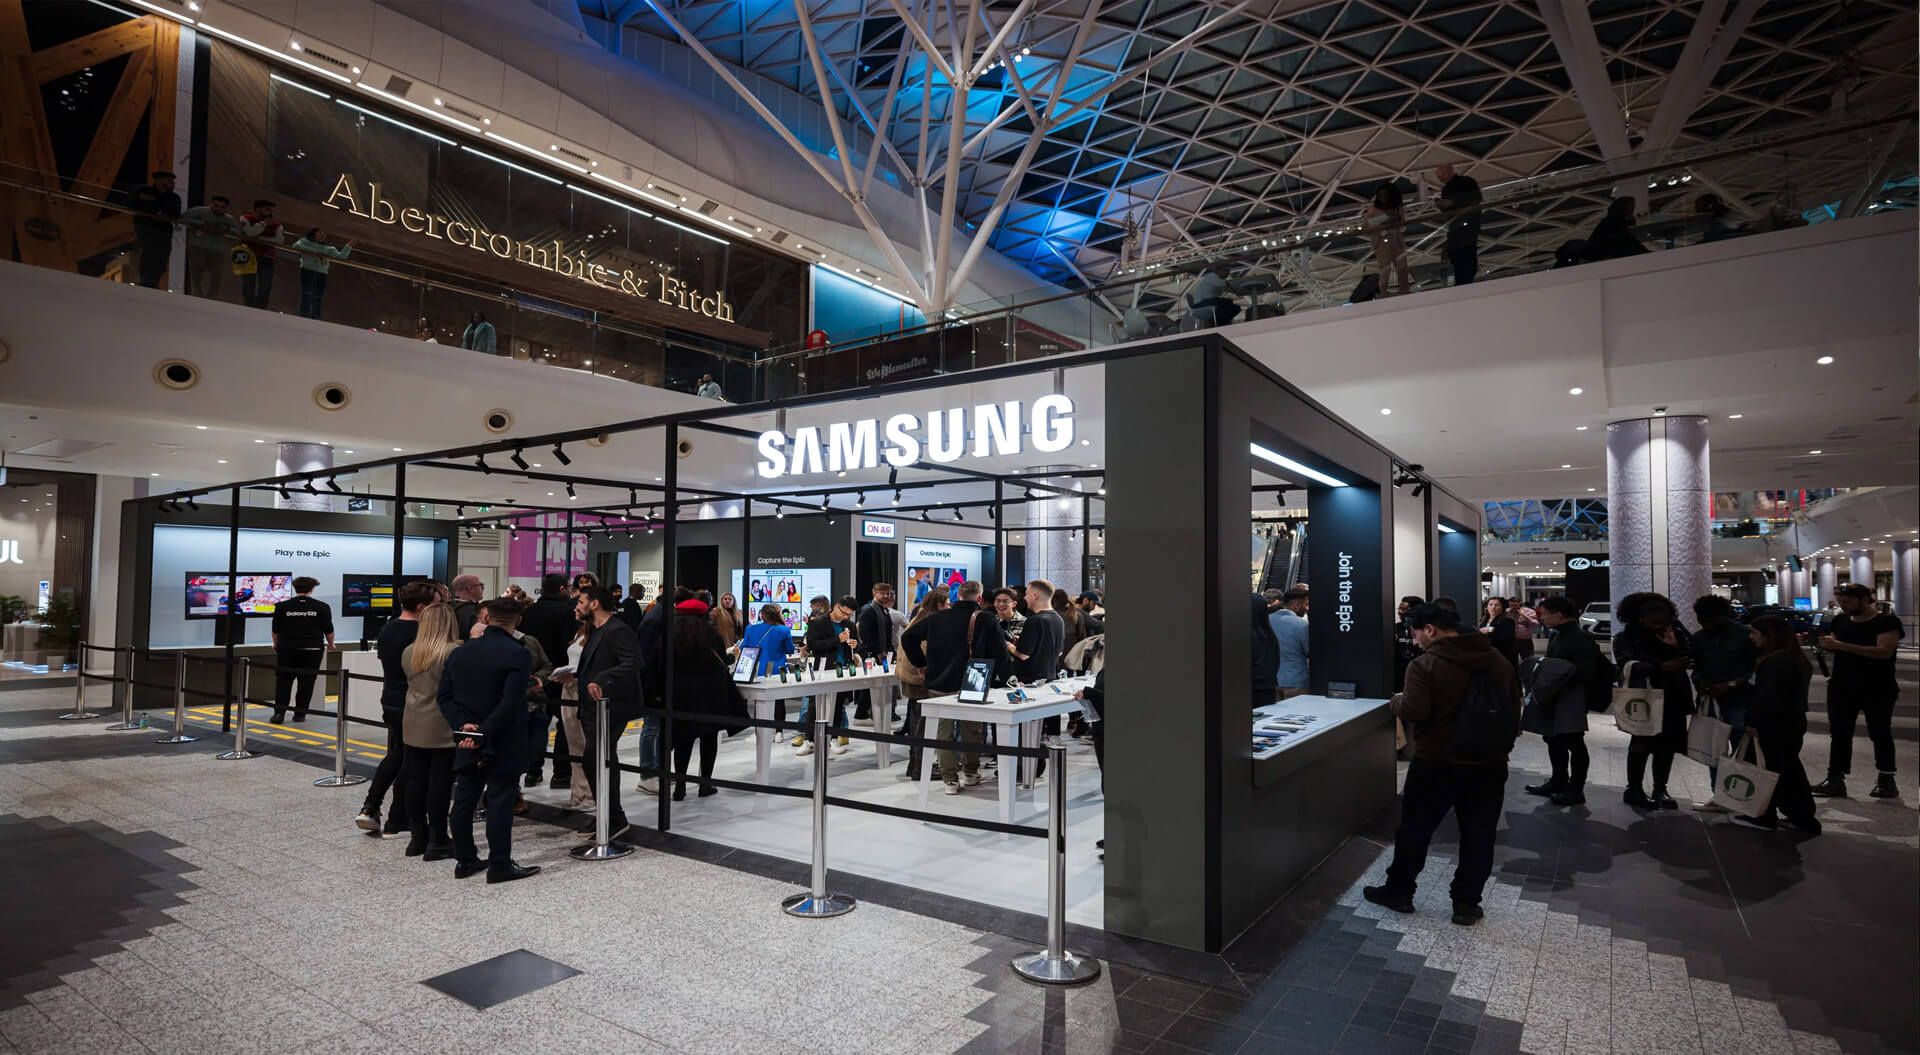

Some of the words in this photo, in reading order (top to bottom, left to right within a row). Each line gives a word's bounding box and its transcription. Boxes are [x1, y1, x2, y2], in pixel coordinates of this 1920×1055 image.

[321, 173, 608, 289] Abercrombie
[620, 269, 649, 298] &
[658, 273, 735, 324] Fitch
[757, 394, 1076, 480] SAMSUNG
[866, 524, 880, 534] ON
[880, 525, 892, 534] AIR
[275, 549, 294, 558] Play
[296, 549, 311, 557] the
[312, 550, 331, 558] Epic
[757, 557, 782, 565] Capture
[782, 556, 792, 564] the
[792, 556, 805, 565] Epic
[919, 549, 935, 557] Create
[1338, 551, 1354, 578] Join
[1338, 580, 1353, 603] the
[1335, 605, 1354, 632] Epic
